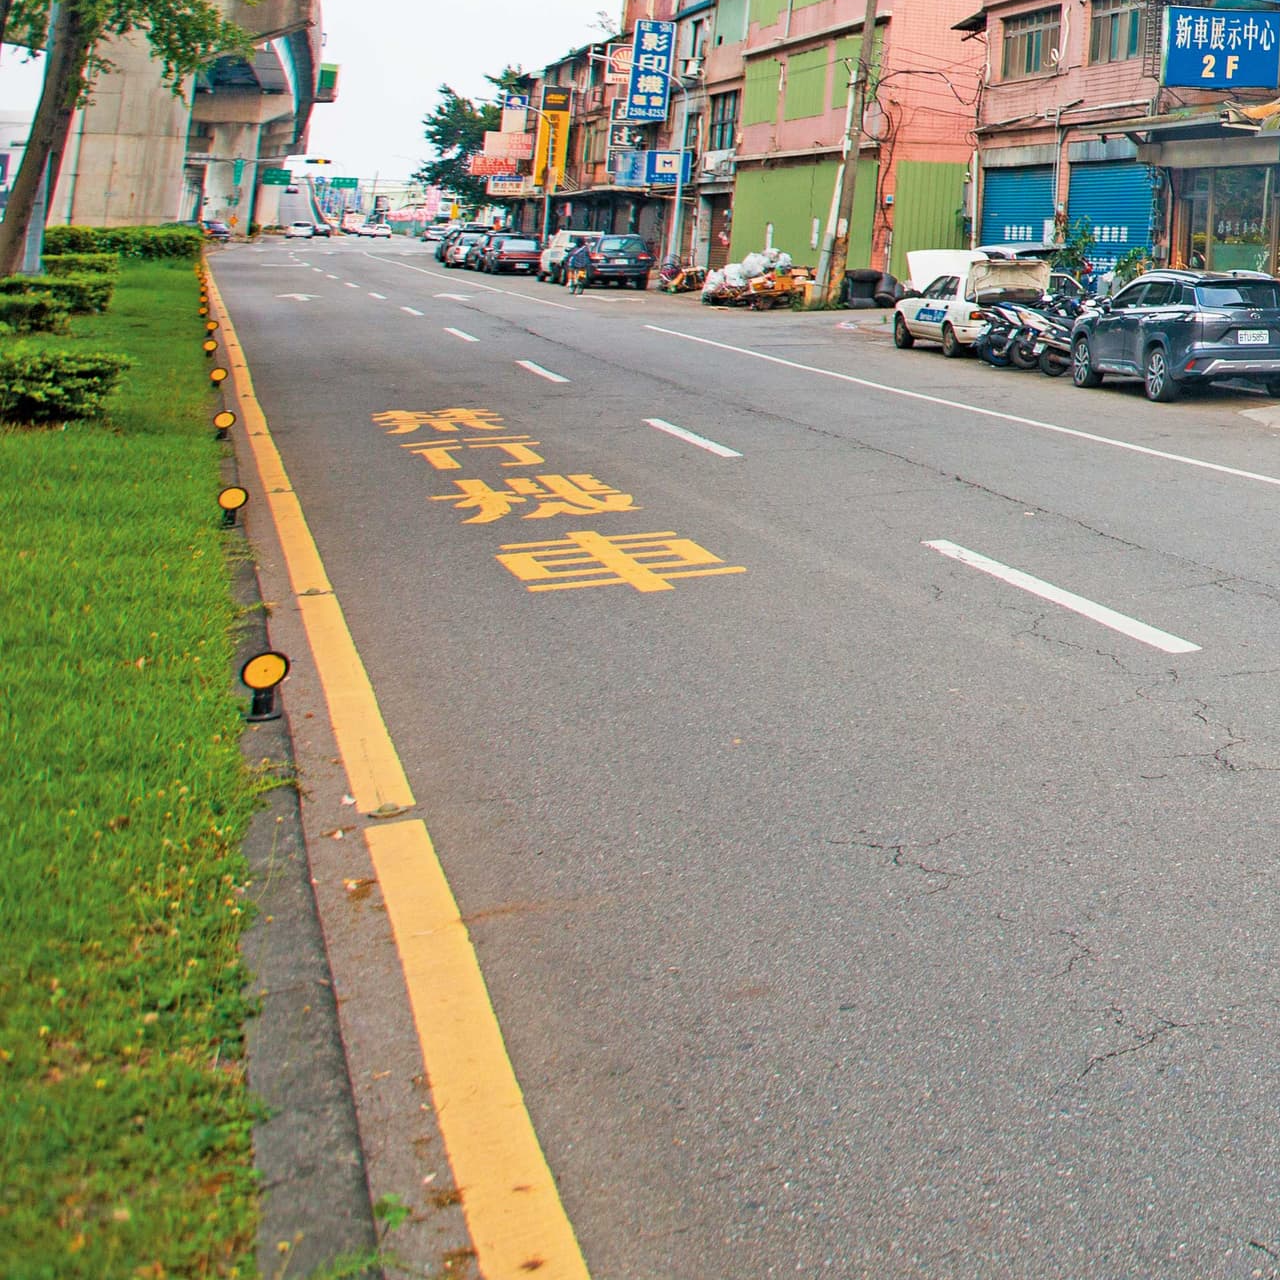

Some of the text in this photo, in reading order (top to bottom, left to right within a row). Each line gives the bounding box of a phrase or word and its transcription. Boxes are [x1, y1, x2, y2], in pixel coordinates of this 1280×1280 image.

[1175, 13, 1276, 52] 新車展示中心
[371, 407, 747, 593] 禁行機車
